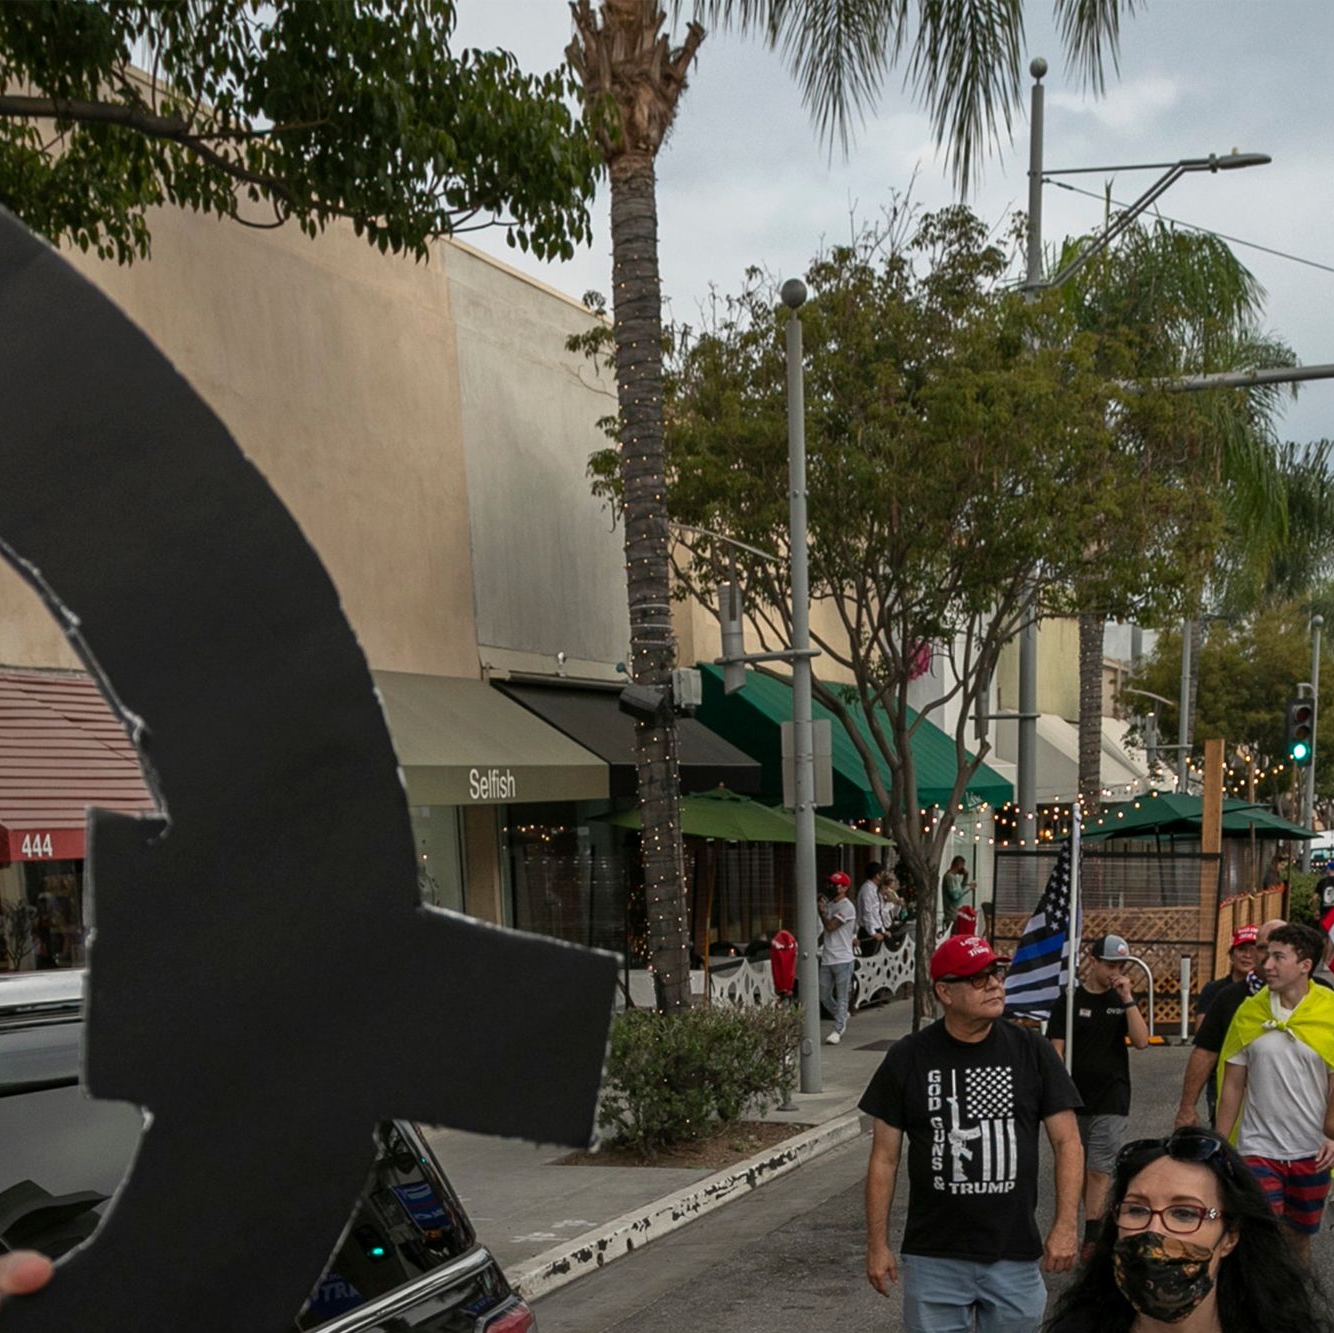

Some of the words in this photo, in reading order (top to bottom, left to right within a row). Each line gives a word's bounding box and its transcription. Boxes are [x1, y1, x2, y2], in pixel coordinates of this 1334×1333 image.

[468, 768, 517, 800] Selfish
[21, 833, 54, 857] 444
[927, 1069, 942, 1112] GOD
[930, 1116, 946, 1171] GUNS
[933, 1175, 945, 1191] &
[948, 1181, 1016, 1195] TRUMP
